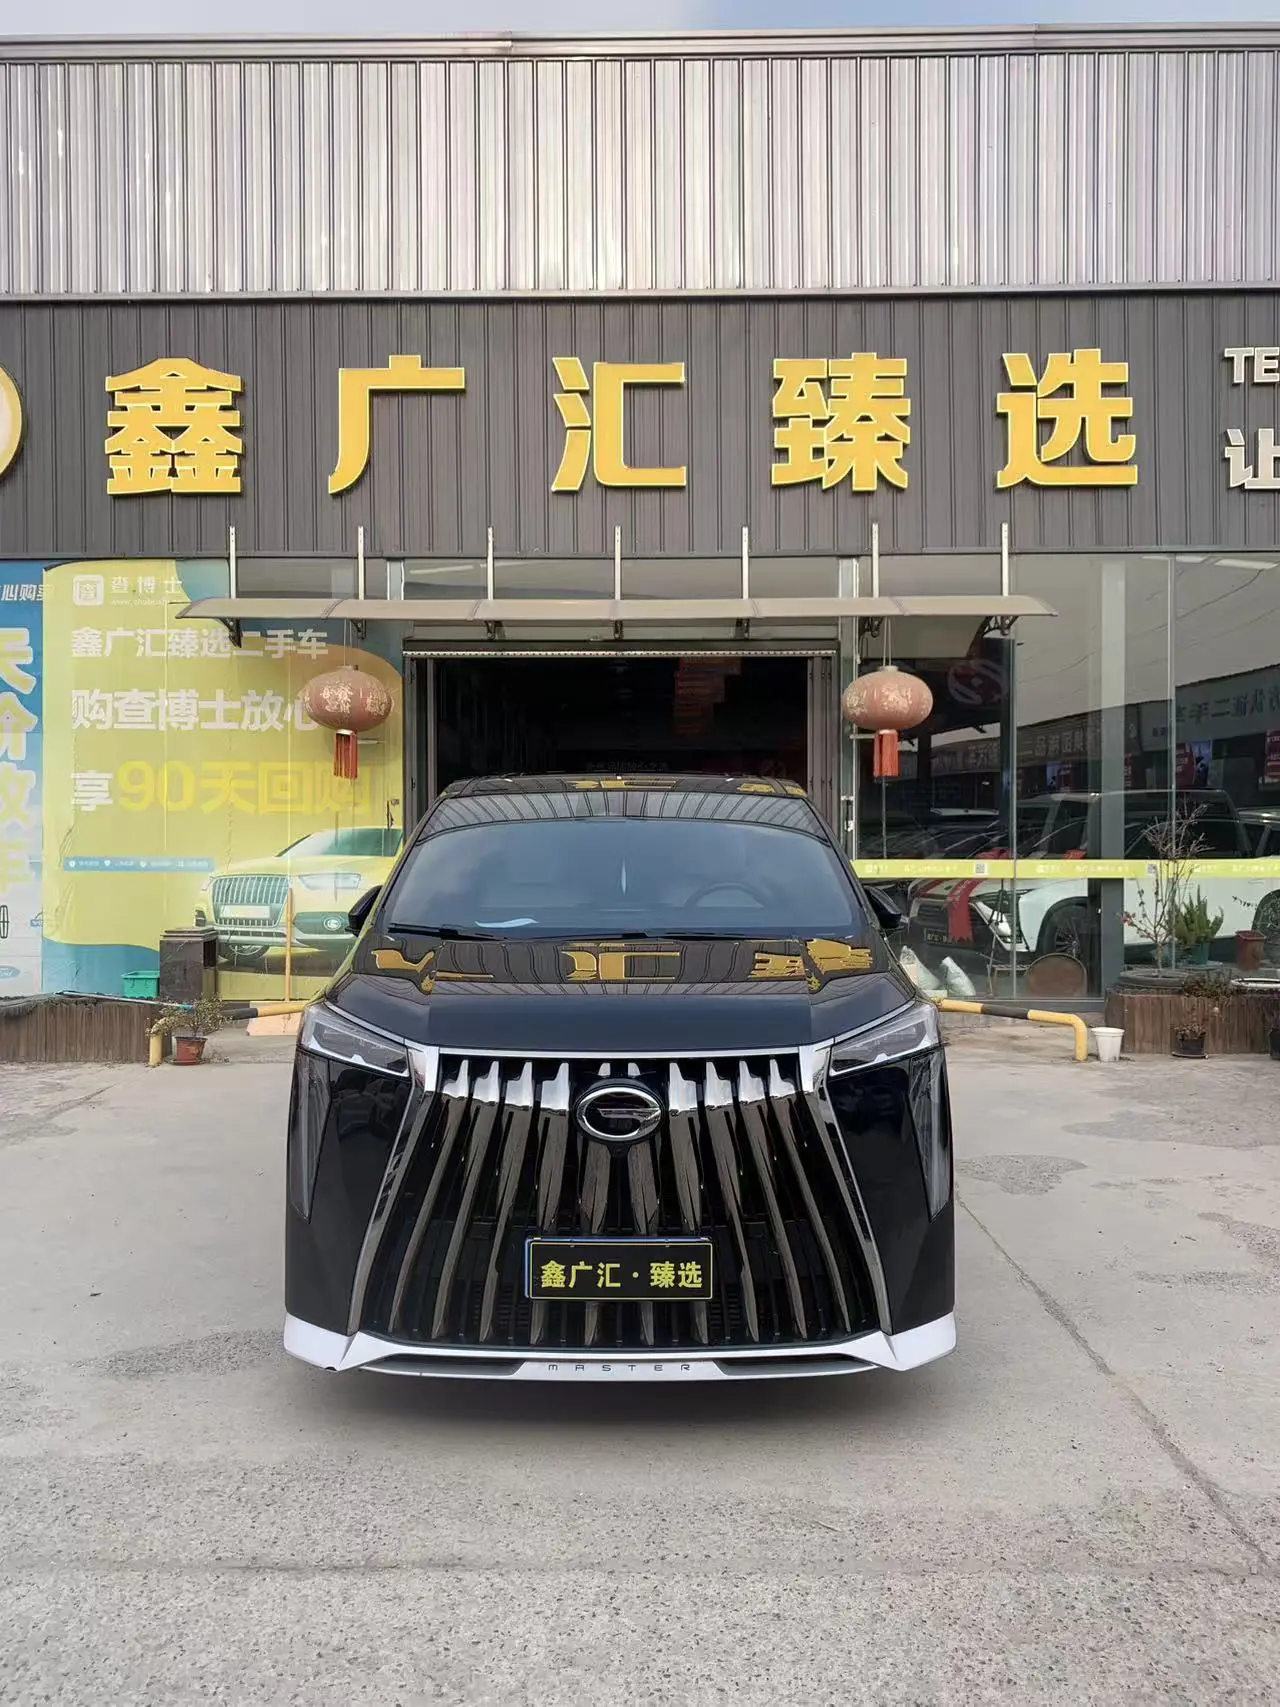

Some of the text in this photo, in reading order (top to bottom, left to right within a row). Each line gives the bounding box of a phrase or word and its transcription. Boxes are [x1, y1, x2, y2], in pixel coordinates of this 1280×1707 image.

[1224, 347, 1280, 383] TE
[105, 348, 1138, 496] 鑫广汇臻选
[71, 627, 329, 660] 鑫广汇臻选二手车
[548, 1364, 691, 1372] MASTER
